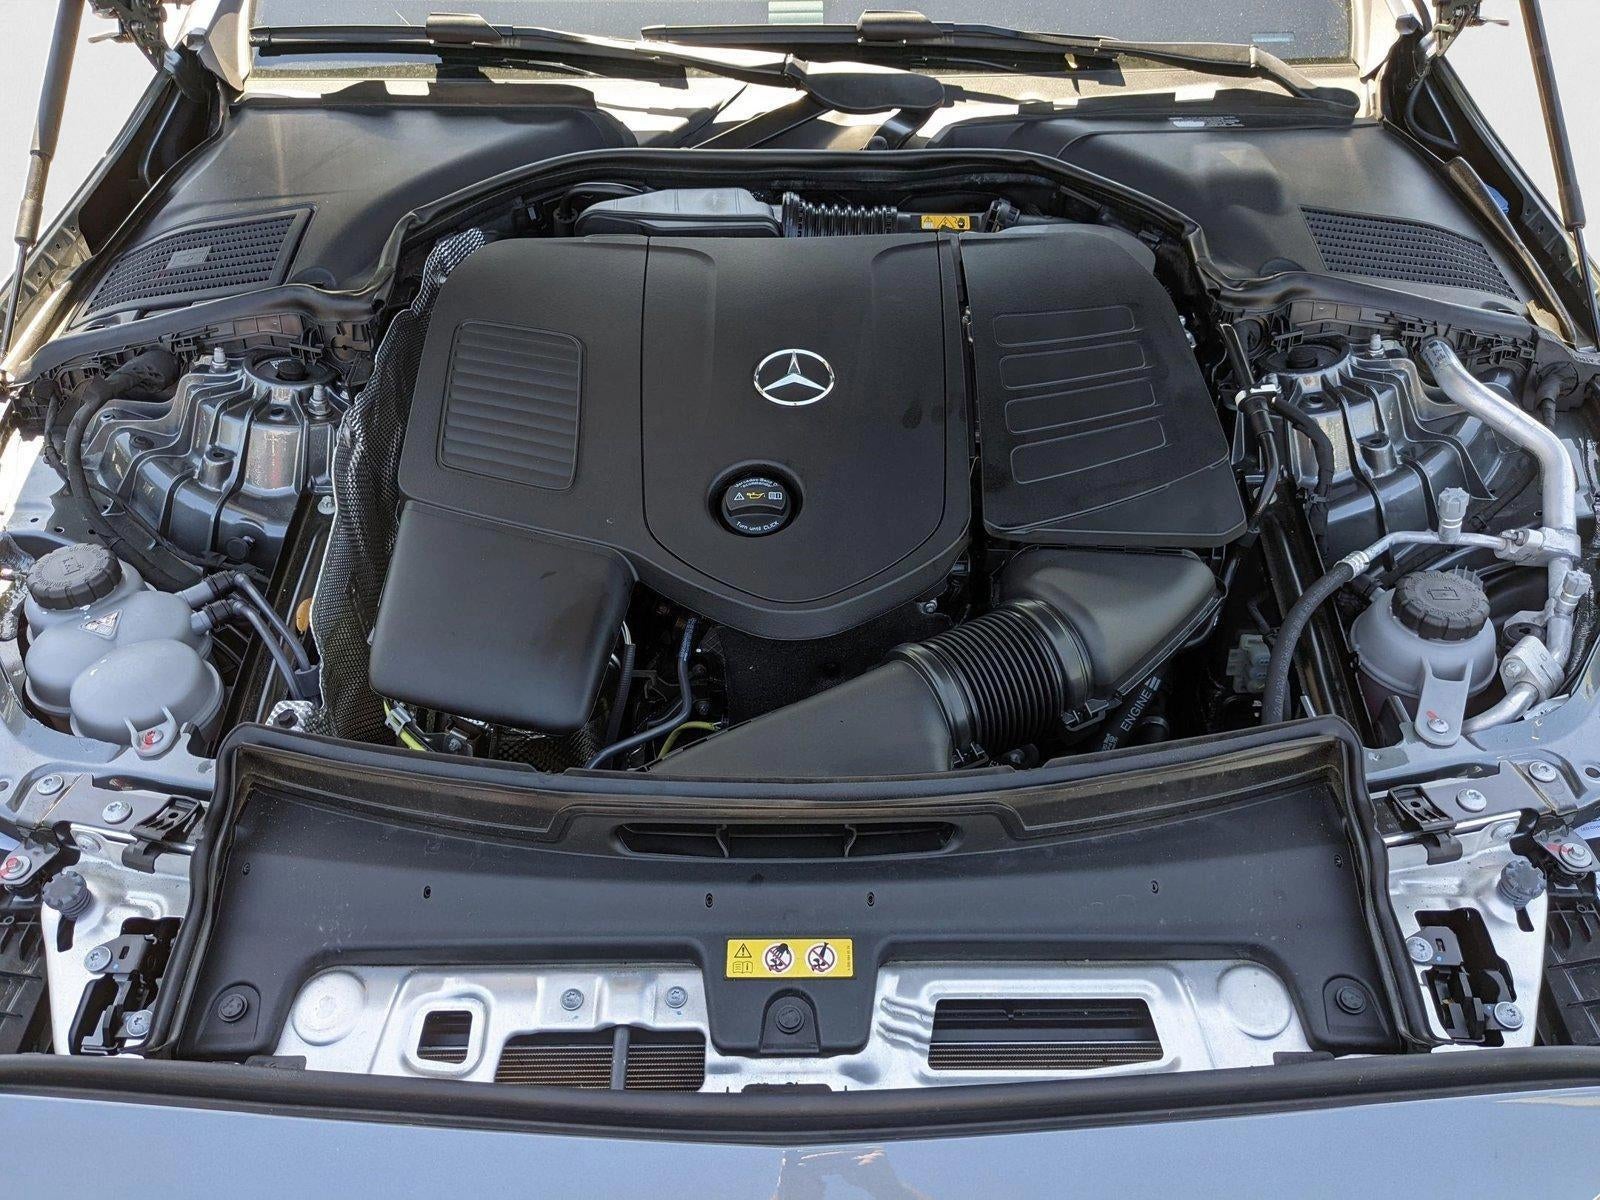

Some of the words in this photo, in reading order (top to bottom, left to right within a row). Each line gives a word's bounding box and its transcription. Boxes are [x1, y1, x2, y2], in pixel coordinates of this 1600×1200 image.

[736, 520, 748, 530] Turn
[763, 520, 779, 531] CLICK
[1120, 689, 1152, 732] ENGINE
